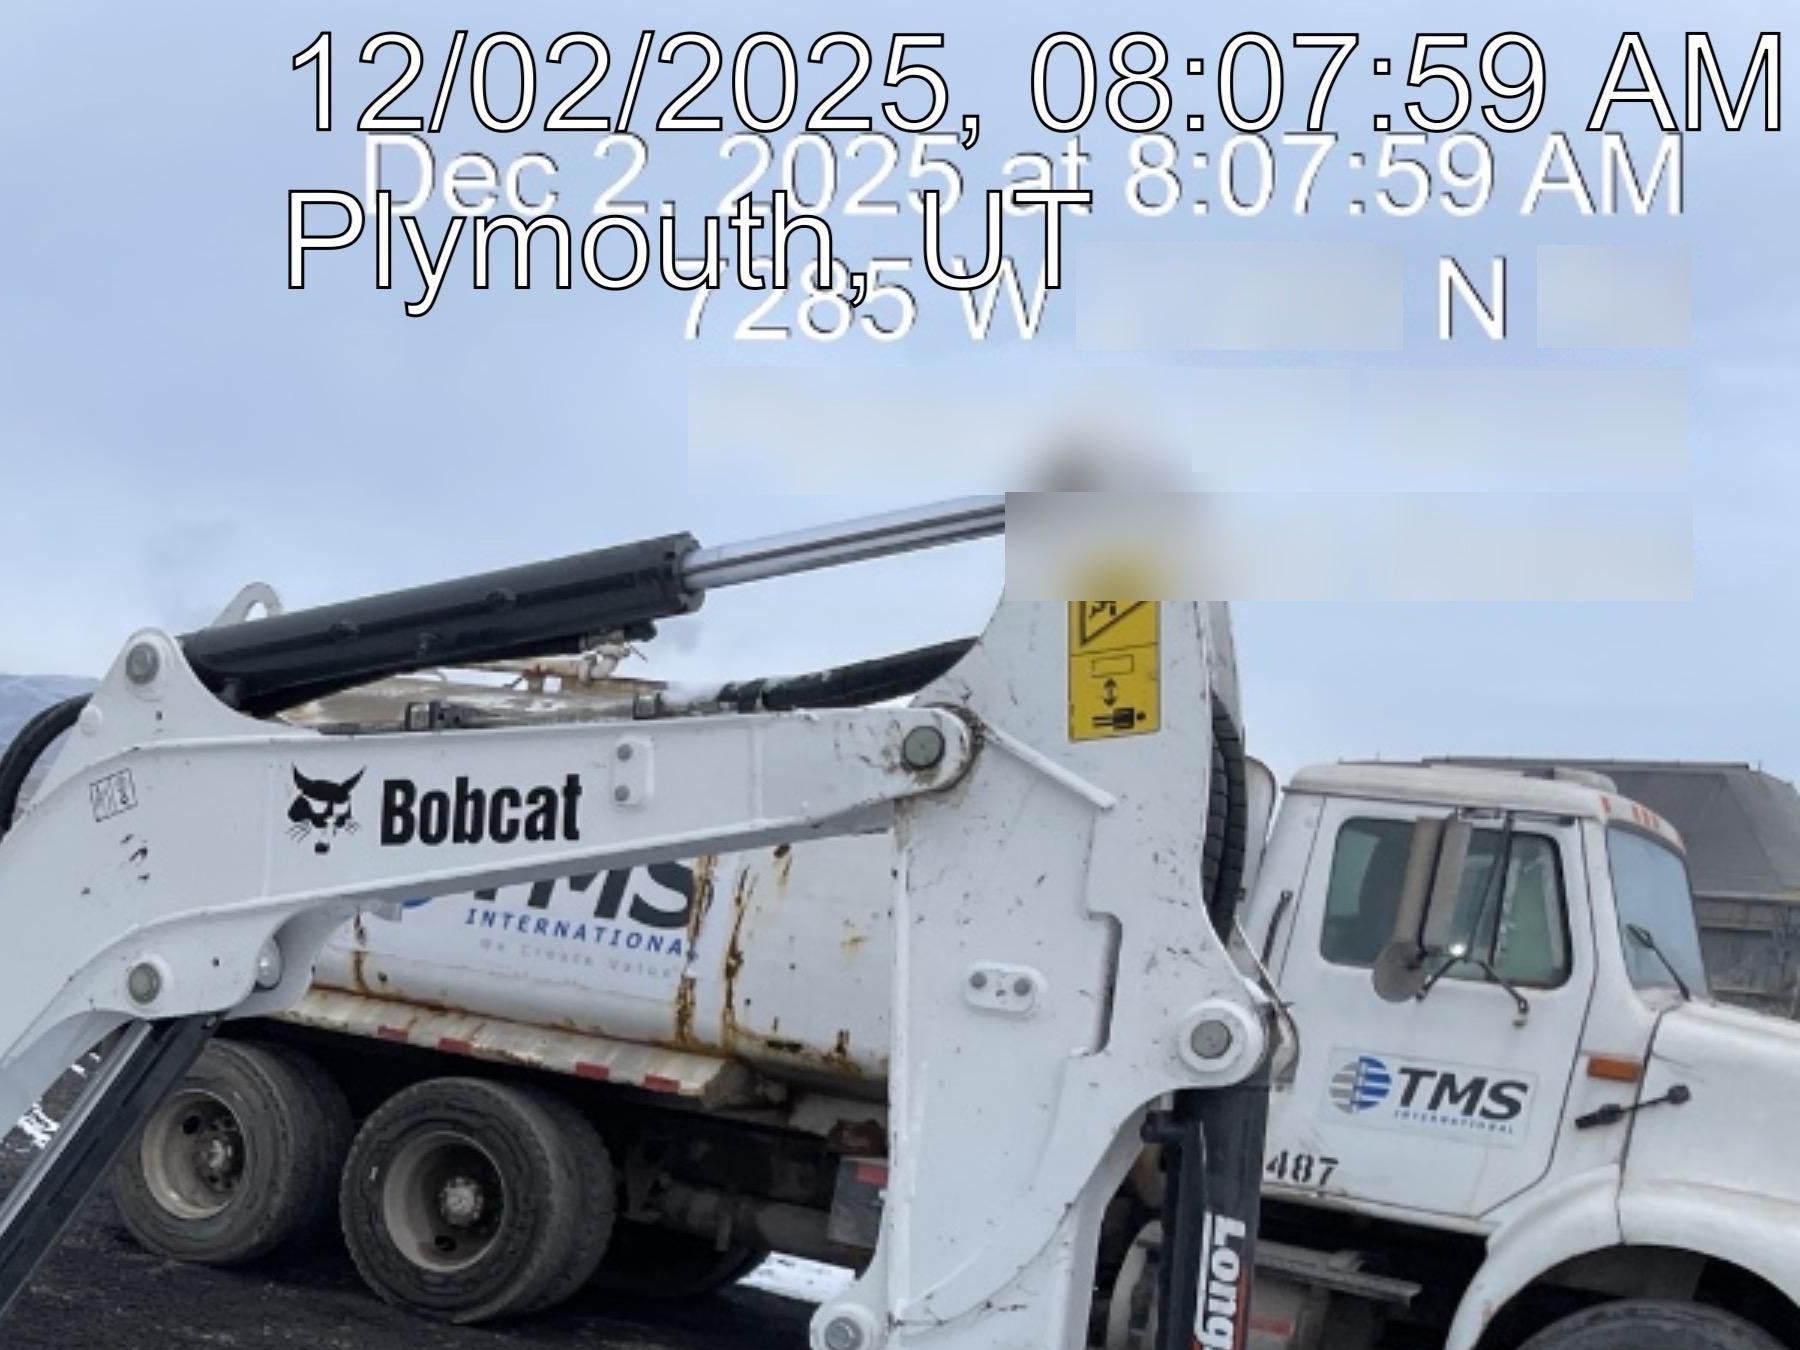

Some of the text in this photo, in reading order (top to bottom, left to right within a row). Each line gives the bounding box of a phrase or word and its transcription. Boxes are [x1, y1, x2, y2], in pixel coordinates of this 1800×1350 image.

[380, 773, 583, 847] Bobcat
[1398, 1067, 1529, 1121] TMS
[1265, 1150, 1340, 1187] 487
